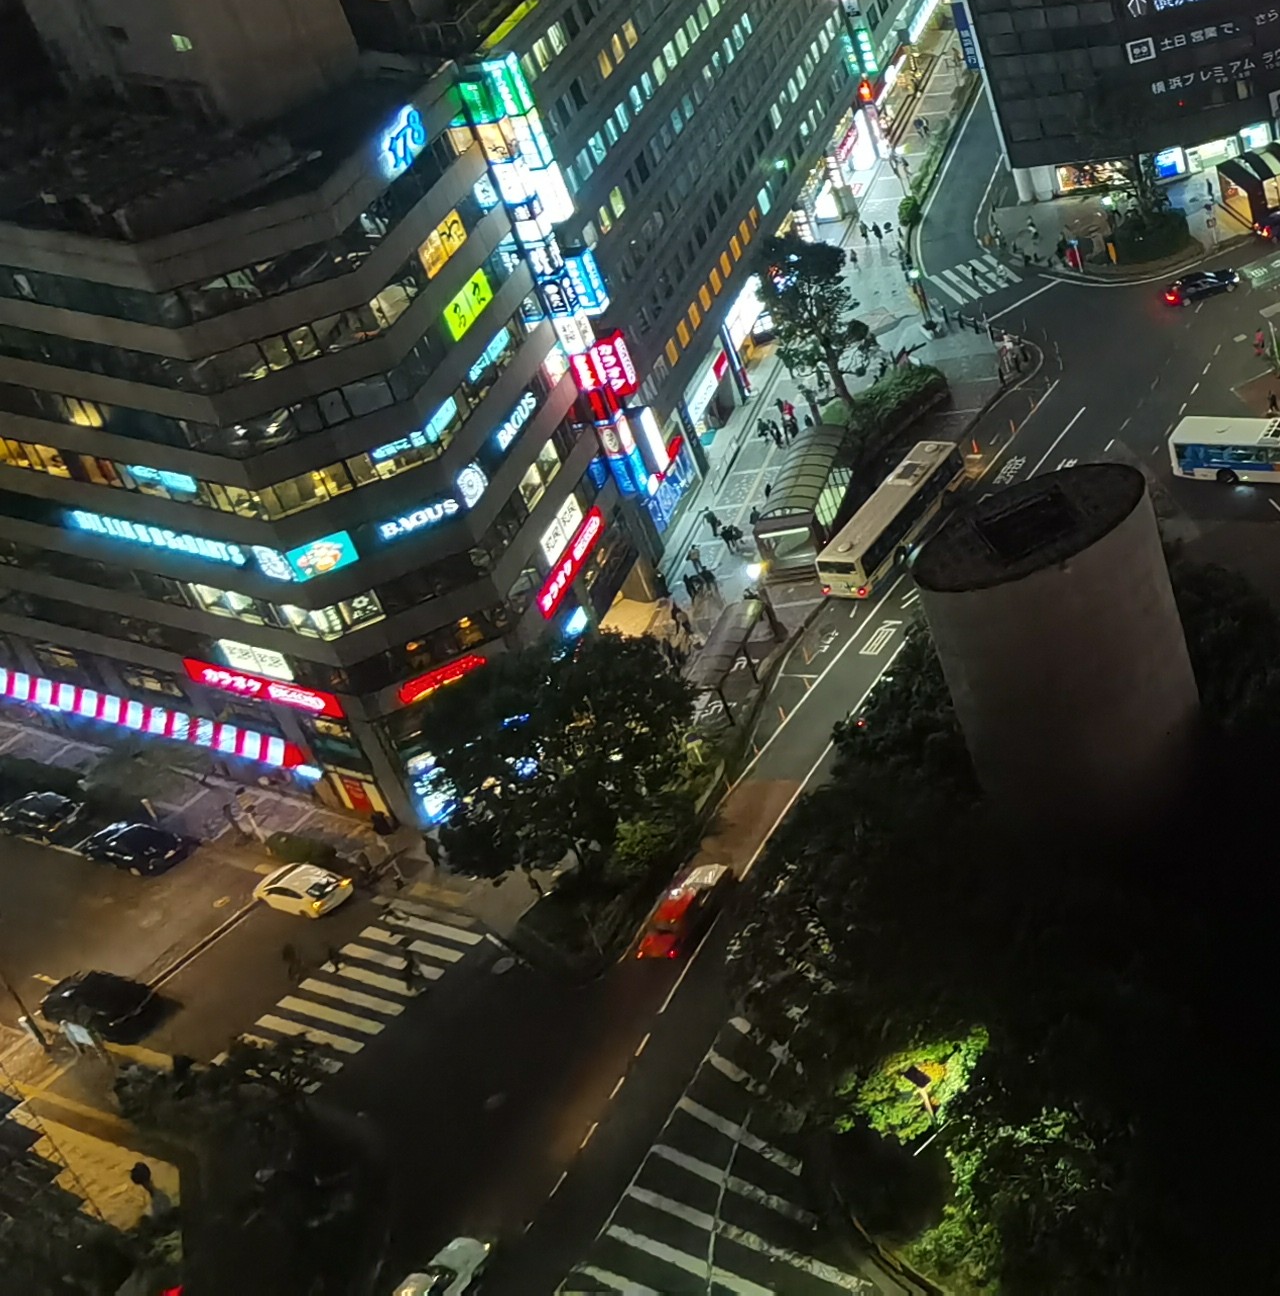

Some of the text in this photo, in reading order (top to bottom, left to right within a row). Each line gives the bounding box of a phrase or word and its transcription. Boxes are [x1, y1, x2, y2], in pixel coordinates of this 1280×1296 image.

[496, 392, 538, 452] BAGUS
[380, 498, 459, 540] BAGUS
[202, 668, 262, 692] カラオケ
